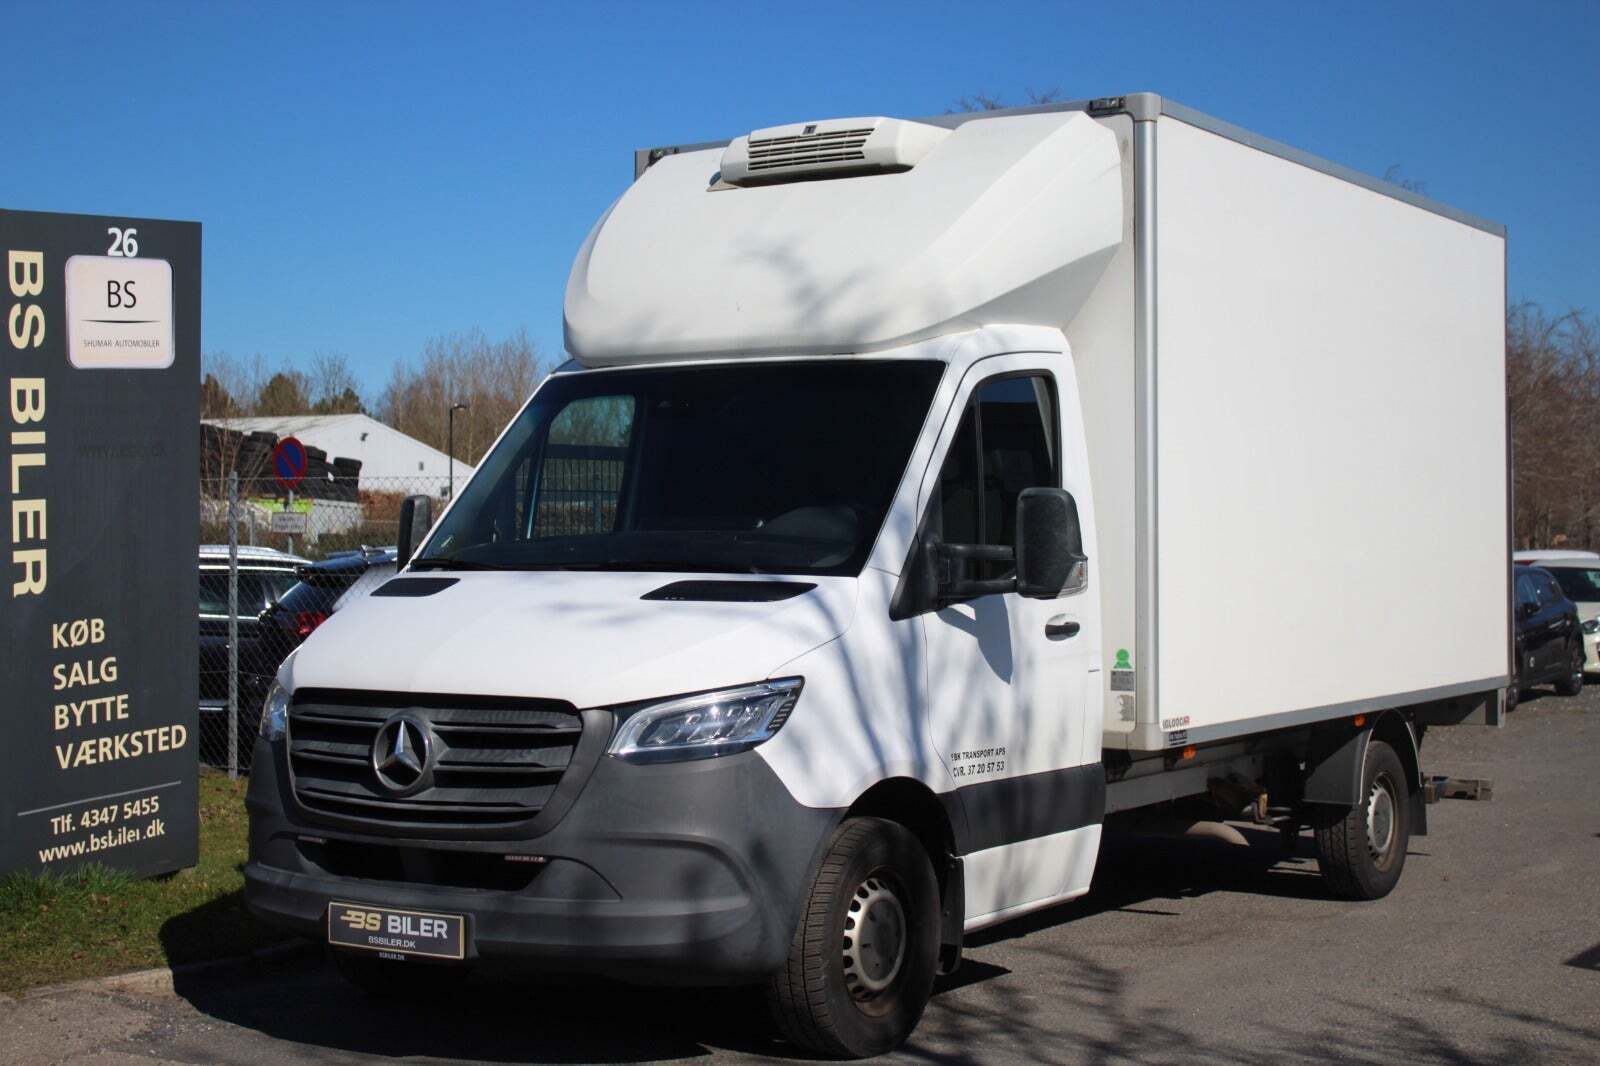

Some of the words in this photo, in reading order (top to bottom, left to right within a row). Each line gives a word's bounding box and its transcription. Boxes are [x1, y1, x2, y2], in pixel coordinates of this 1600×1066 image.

[107, 227, 138, 258] 26
[8, 250, 46, 349] BS
[107, 280, 137, 308] BS
[115, 339, 160, 348] AUTOMOBILER
[10, 377, 48, 598] BILER
[53, 618, 105, 649] KØB
[53, 657, 118, 690] SALG
[54, 694, 129, 730] BYTTE
[56, 724, 187, 770] VÆRKSTED
[962, 748, 994, 760] TRANSPORT
[995, 747, 1006, 756] APS
[967, 764, 976, 776] 37
[977, 763, 986, 774] 20
[986, 762, 995, 773] 57
[996, 760, 1005, 772] 53
[50, 813, 76, 835] Tlf.
[80, 805, 118, 828] 4347
[123, 795, 160, 820] 5455
[368, 935, 416, 949] BSBILER.DK
[387, 915, 448, 939] BILER
